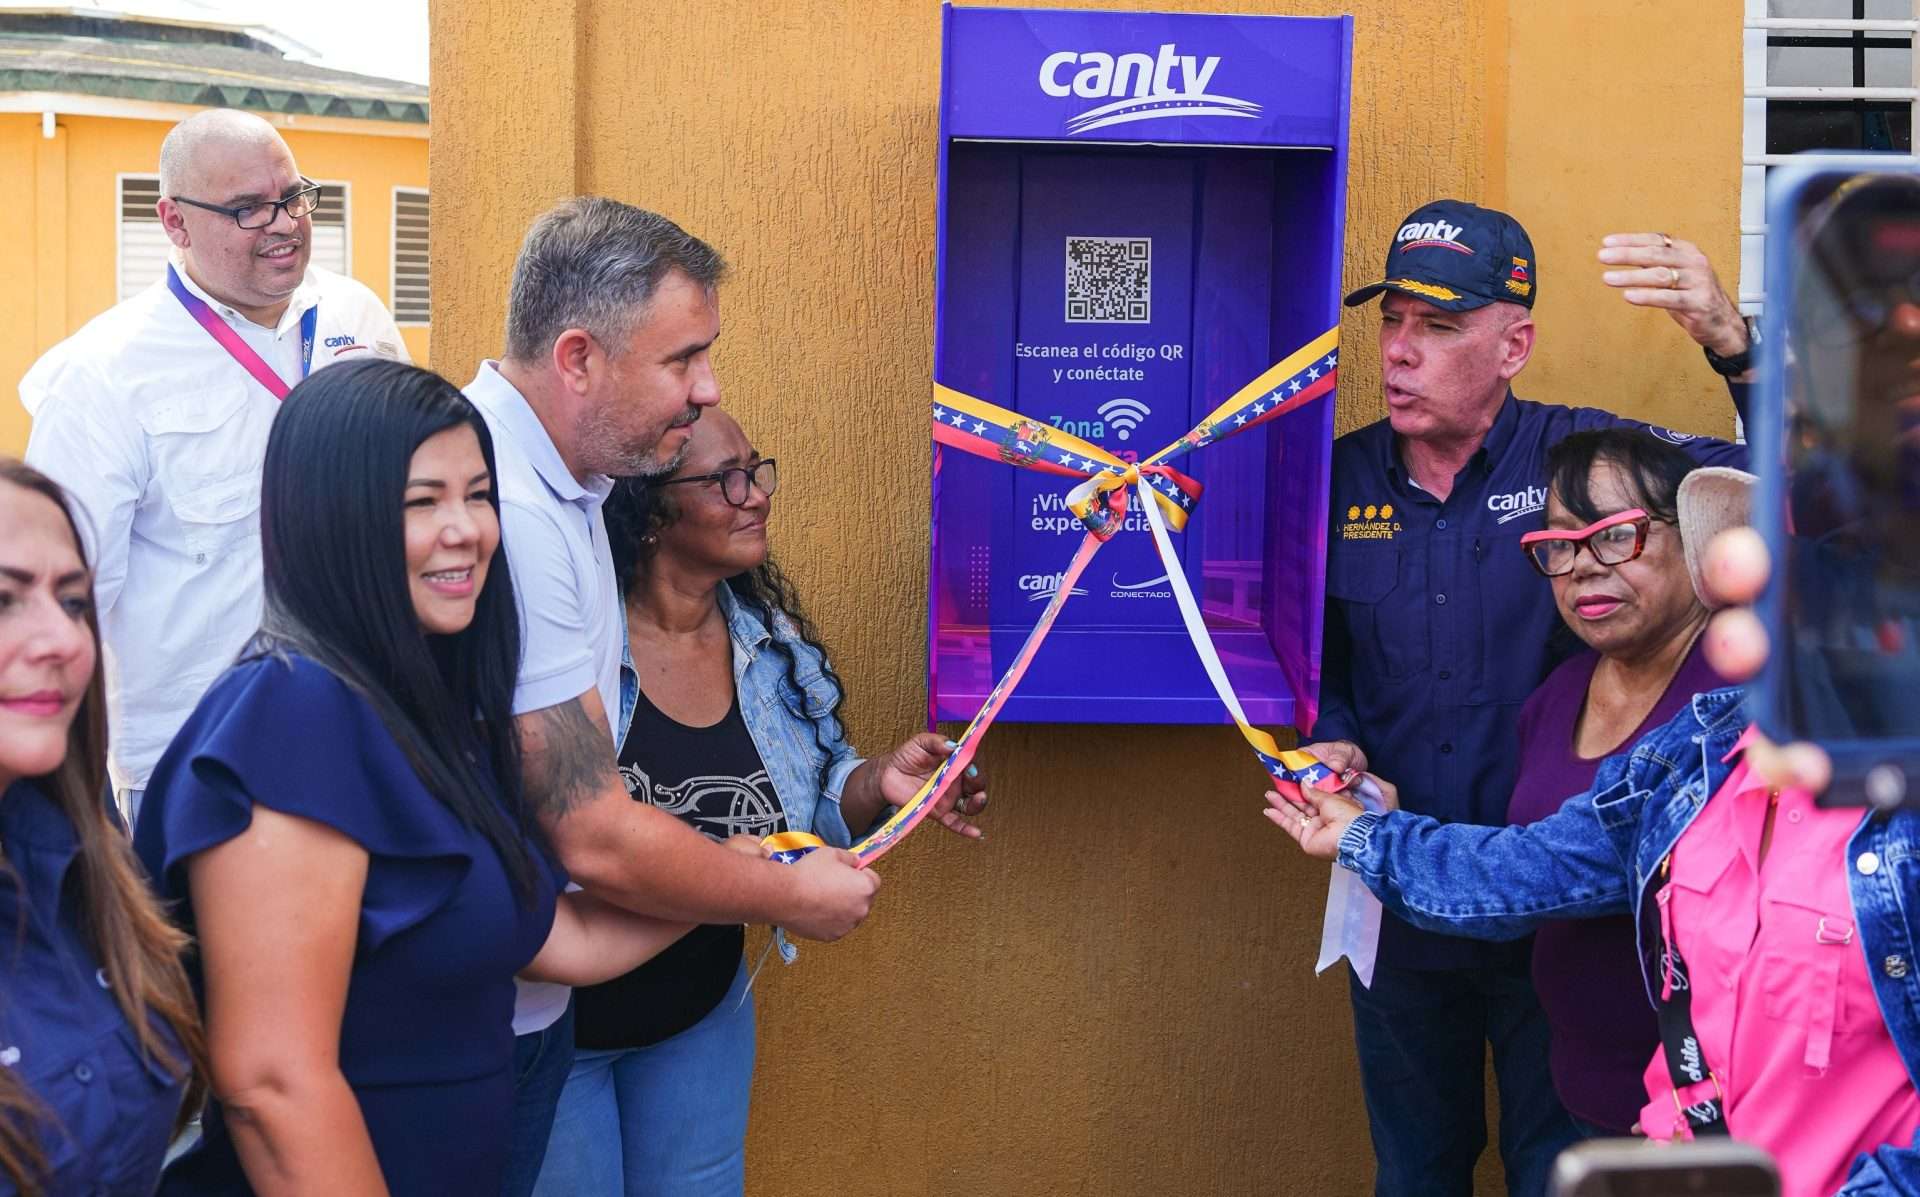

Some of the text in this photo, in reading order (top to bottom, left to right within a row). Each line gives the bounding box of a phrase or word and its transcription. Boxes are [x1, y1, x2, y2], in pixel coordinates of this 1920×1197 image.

[1039, 43, 1221, 99] cantv
[1397, 219, 1463, 242] cantv
[1016, 342, 1184, 362] Escanea el código QR
[1053, 365, 1144, 384] y conéctate
[1050, 415, 1105, 439] Zona
[1032, 493, 1067, 516] ¡Viv
[1487, 485, 1548, 512] cantv
[1343, 530, 1393, 540] PRESIDENTE
[1018, 571, 1064, 591] cant
[1110, 591, 1171, 599] CONECTADO
